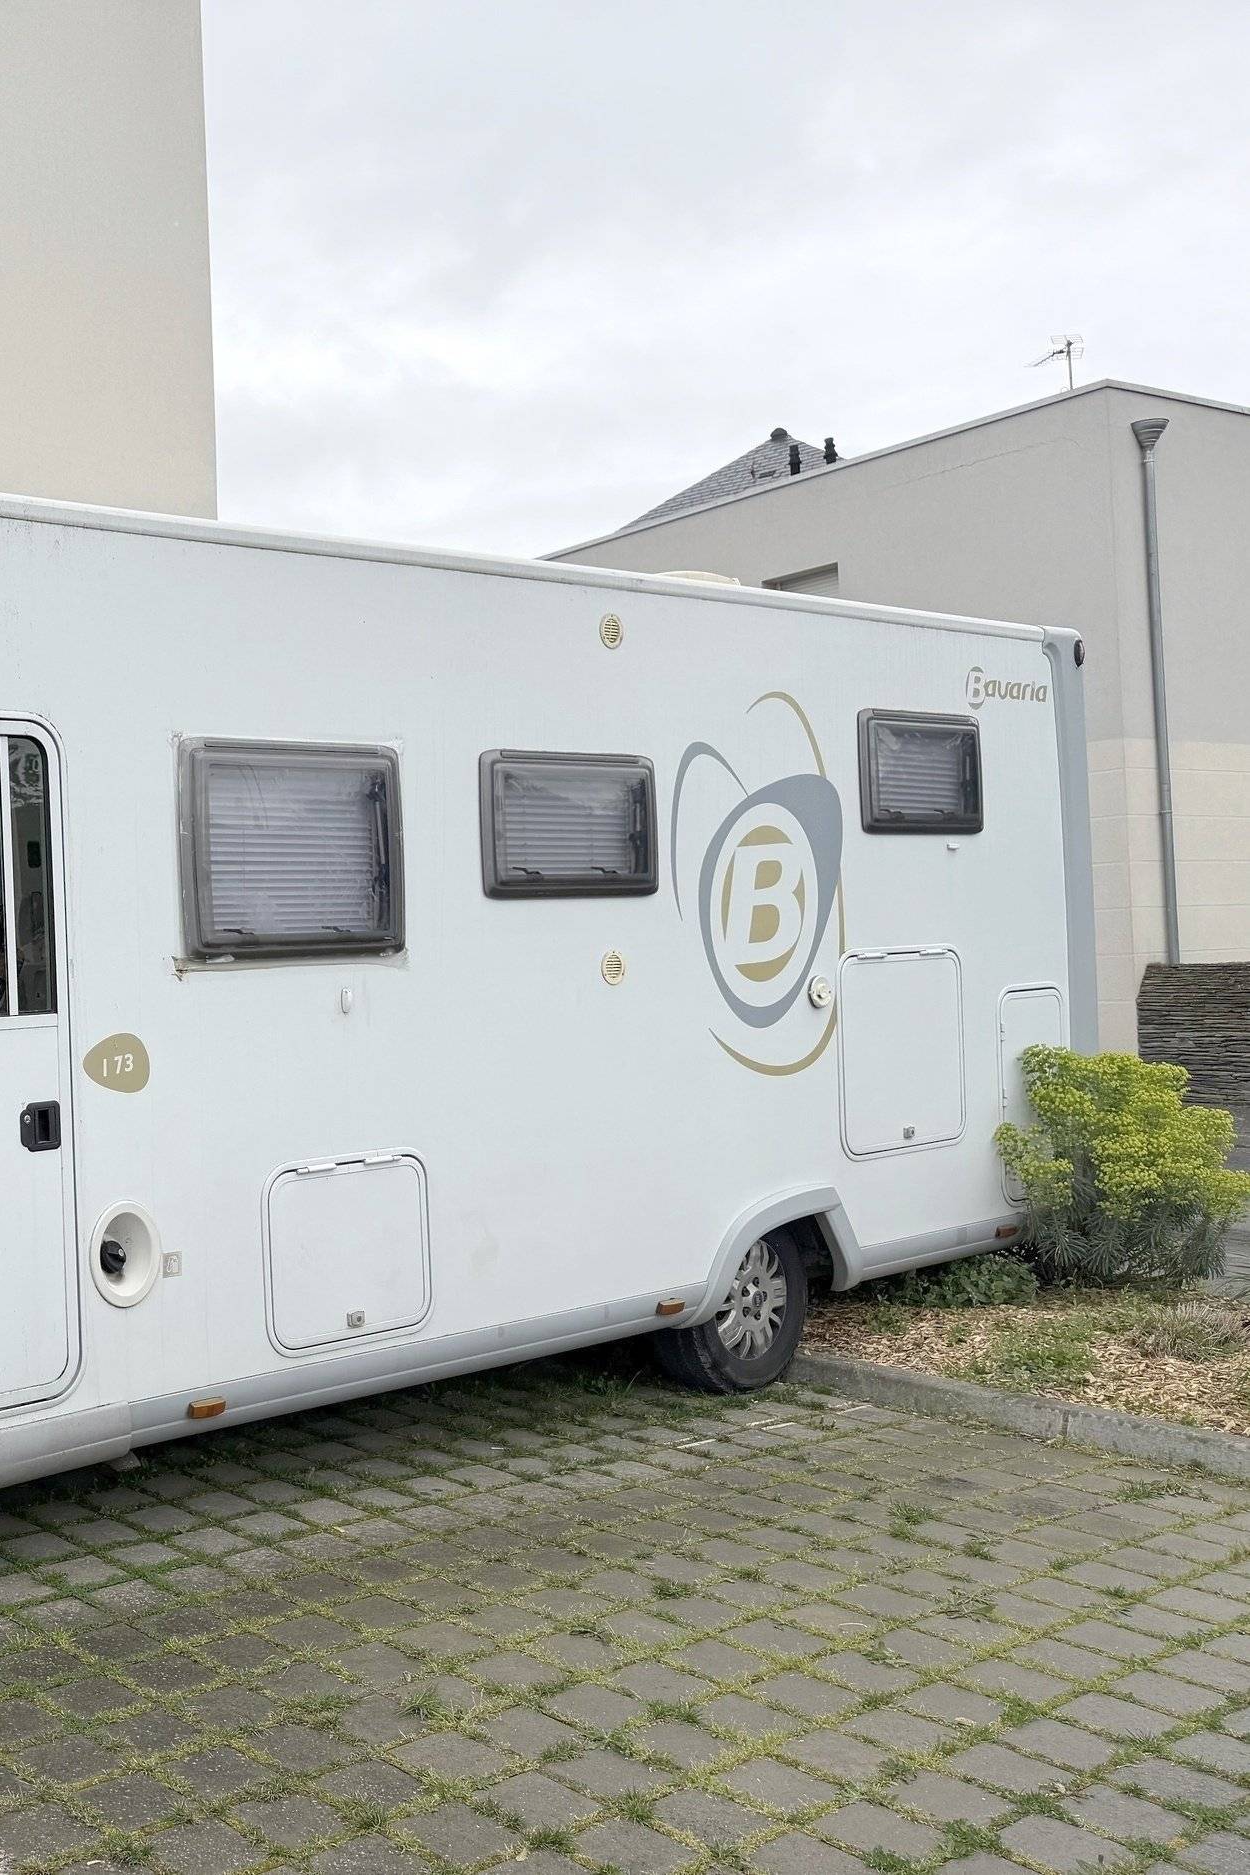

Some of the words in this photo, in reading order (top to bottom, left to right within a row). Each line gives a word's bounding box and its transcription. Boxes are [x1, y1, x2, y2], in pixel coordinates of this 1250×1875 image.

[966, 666, 1048, 708] Bavaria
[725, 842, 803, 964] B
[113, 1053, 134, 1075] 73
